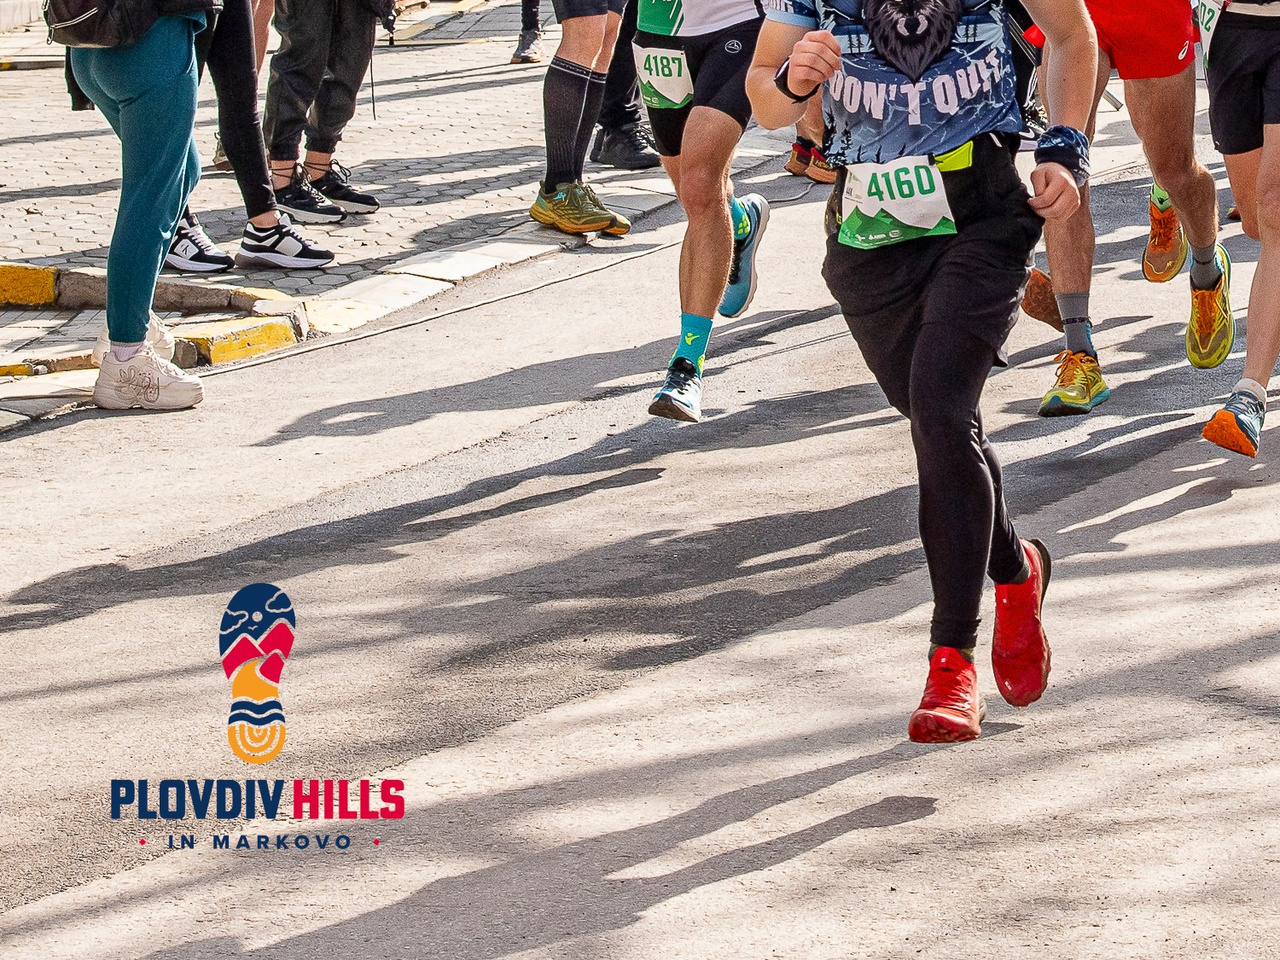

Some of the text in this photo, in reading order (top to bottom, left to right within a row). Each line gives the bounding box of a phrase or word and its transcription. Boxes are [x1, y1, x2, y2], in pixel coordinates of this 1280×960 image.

[643, 54, 683, 77] 4187
[828, 48, 1001, 126] DON'T QUIT
[867, 164, 936, 202] 4160
